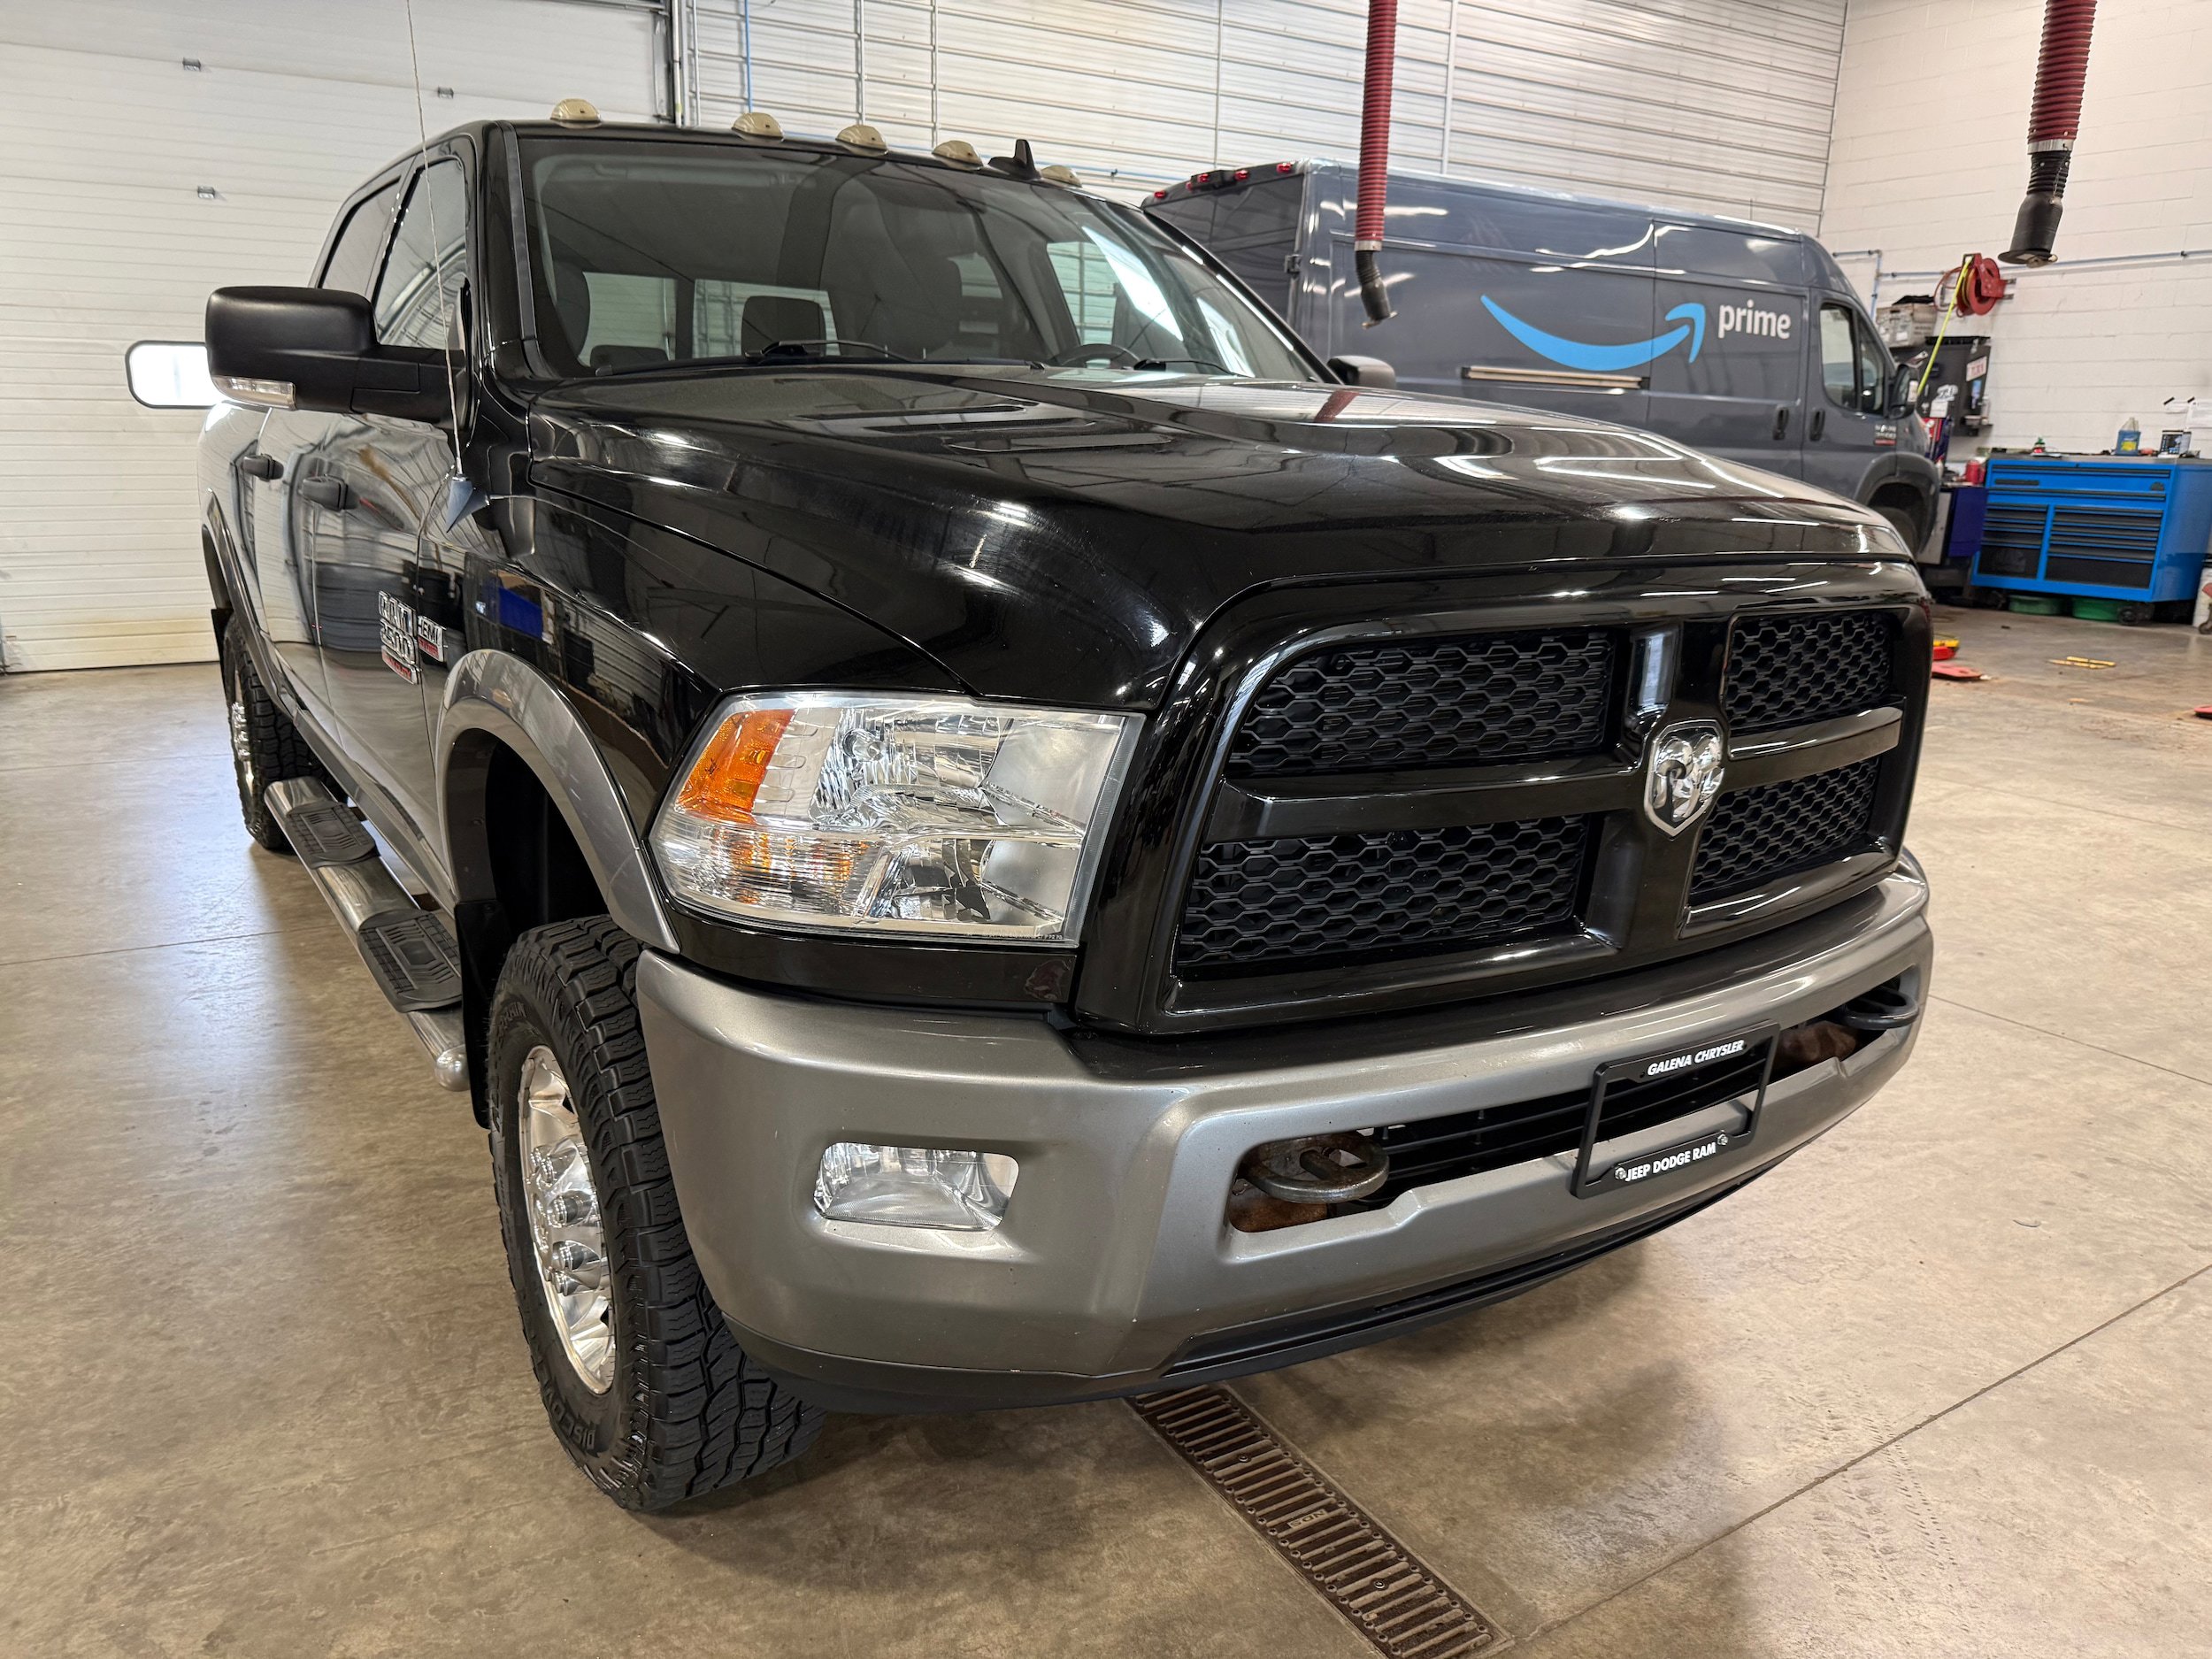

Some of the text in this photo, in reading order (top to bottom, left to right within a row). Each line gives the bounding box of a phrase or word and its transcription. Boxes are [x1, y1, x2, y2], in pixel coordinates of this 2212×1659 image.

[1717, 299, 1791, 340] prime
[379, 590, 416, 638] RAM
[1647, 1040, 1745, 1076] GALENA CHRYSLER
[1624, 1142, 1717, 1182] JEEP DODGE RAM
